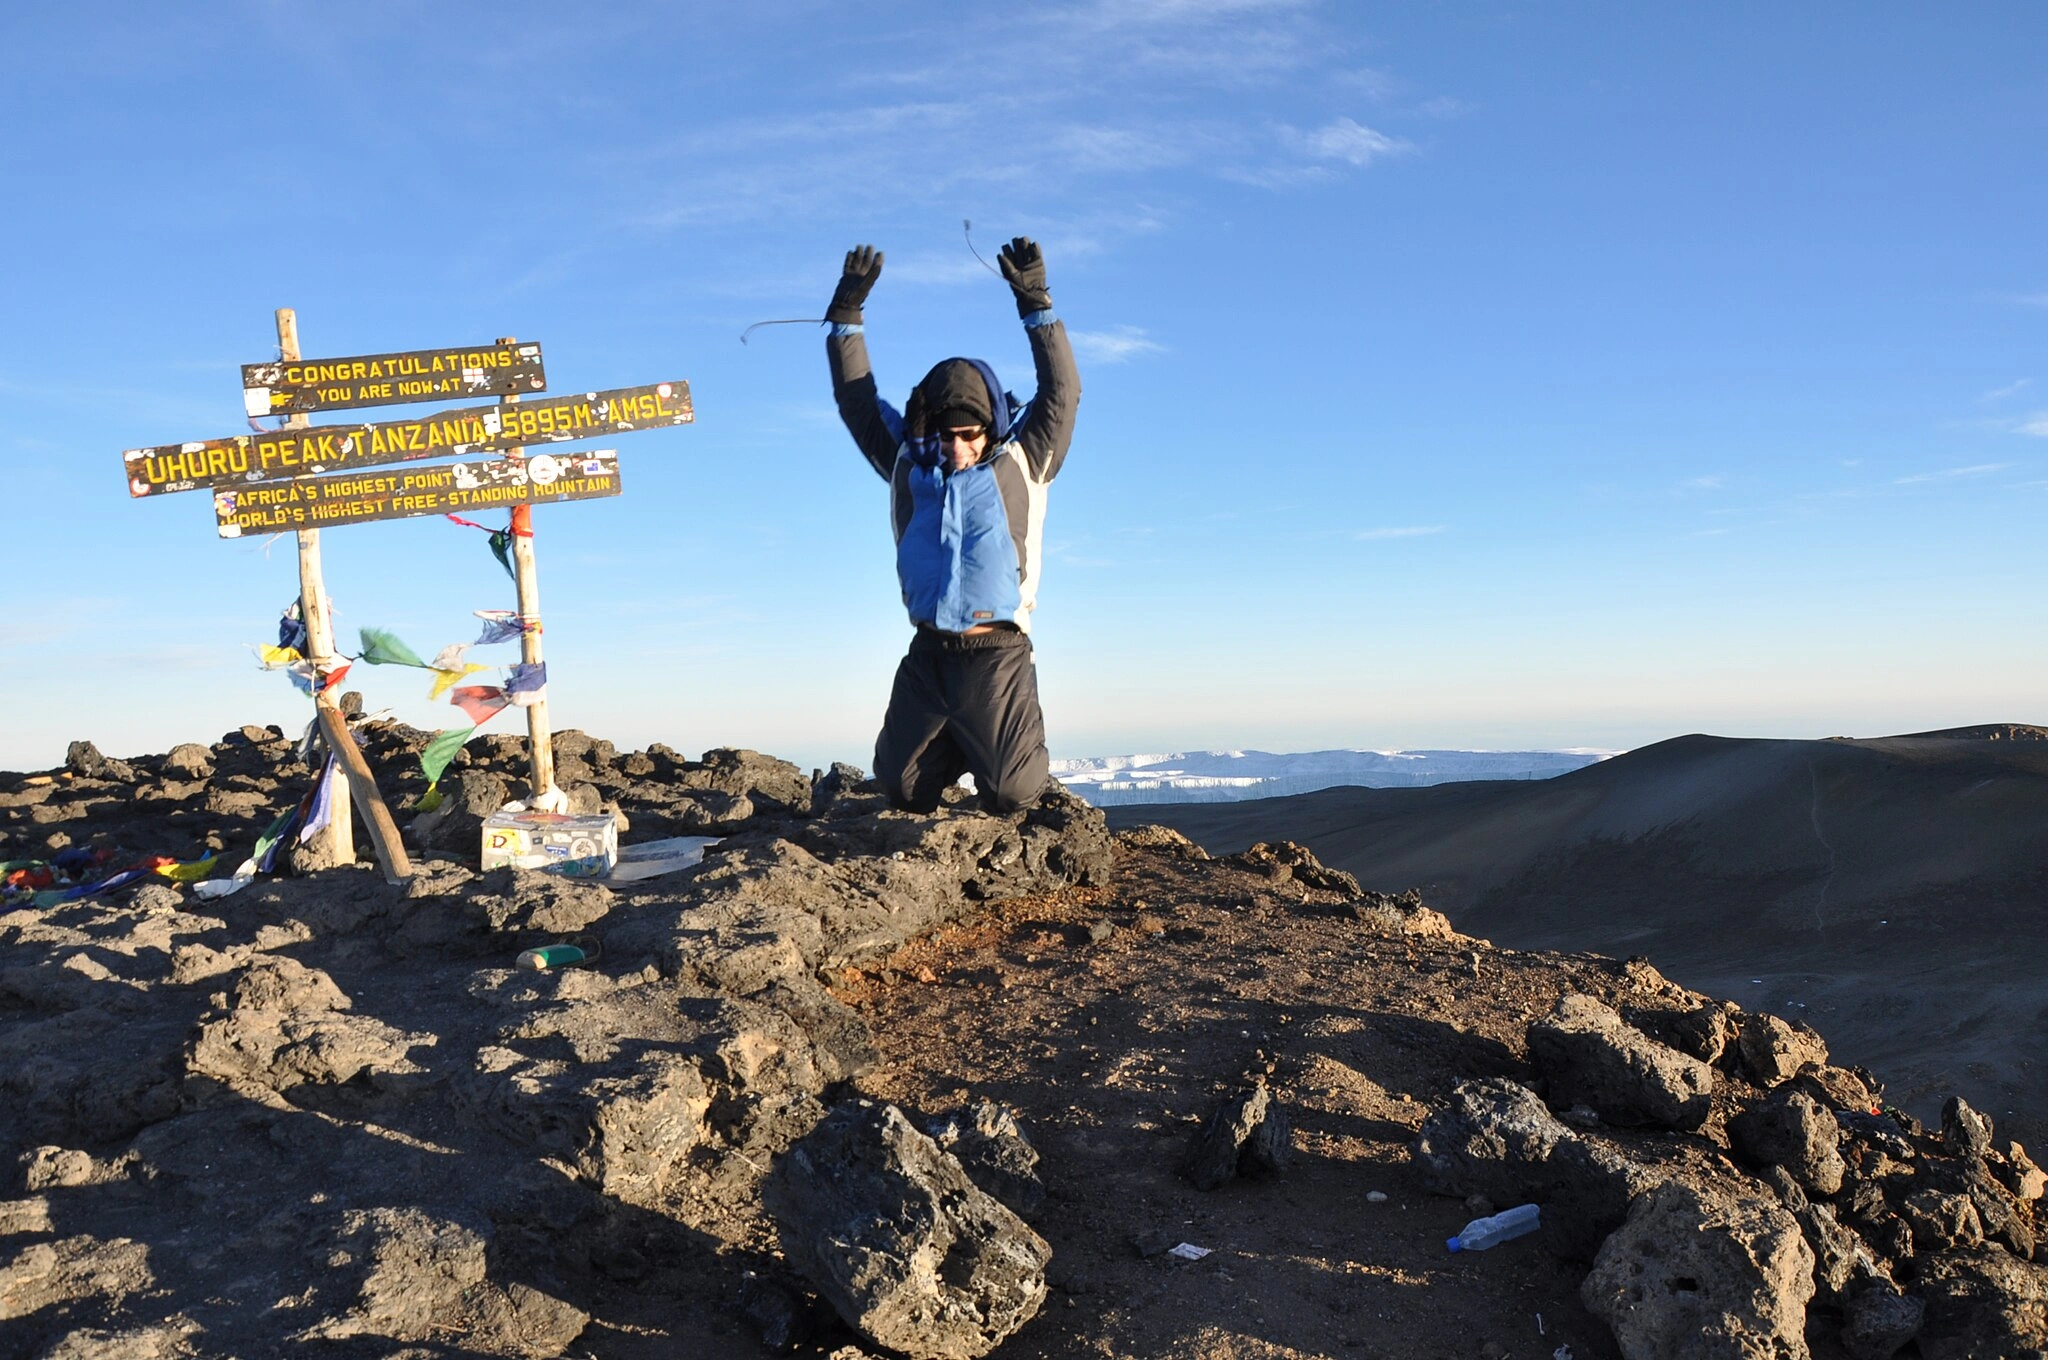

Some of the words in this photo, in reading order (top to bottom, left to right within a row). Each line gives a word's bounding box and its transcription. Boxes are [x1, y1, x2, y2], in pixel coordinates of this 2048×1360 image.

[287, 350, 521, 384] CONGRATULATIONS!
[317, 387, 351, 403] YOU
[359, 383, 391, 400] ARE
[399, 380, 433, 396] NOW
[441, 377, 460, 393] AT
[145, 445, 249, 484] UHURU
[608, 393, 681, 424] AMSL.
[236, 484, 317, 507] AFRICA'S
[324, 477, 396, 498] HIGHEST
[404, 472, 452, 489] POINT
[311, 499, 384, 520] HIGHEST
[533, 477, 610, 497] MOUNTAIN
